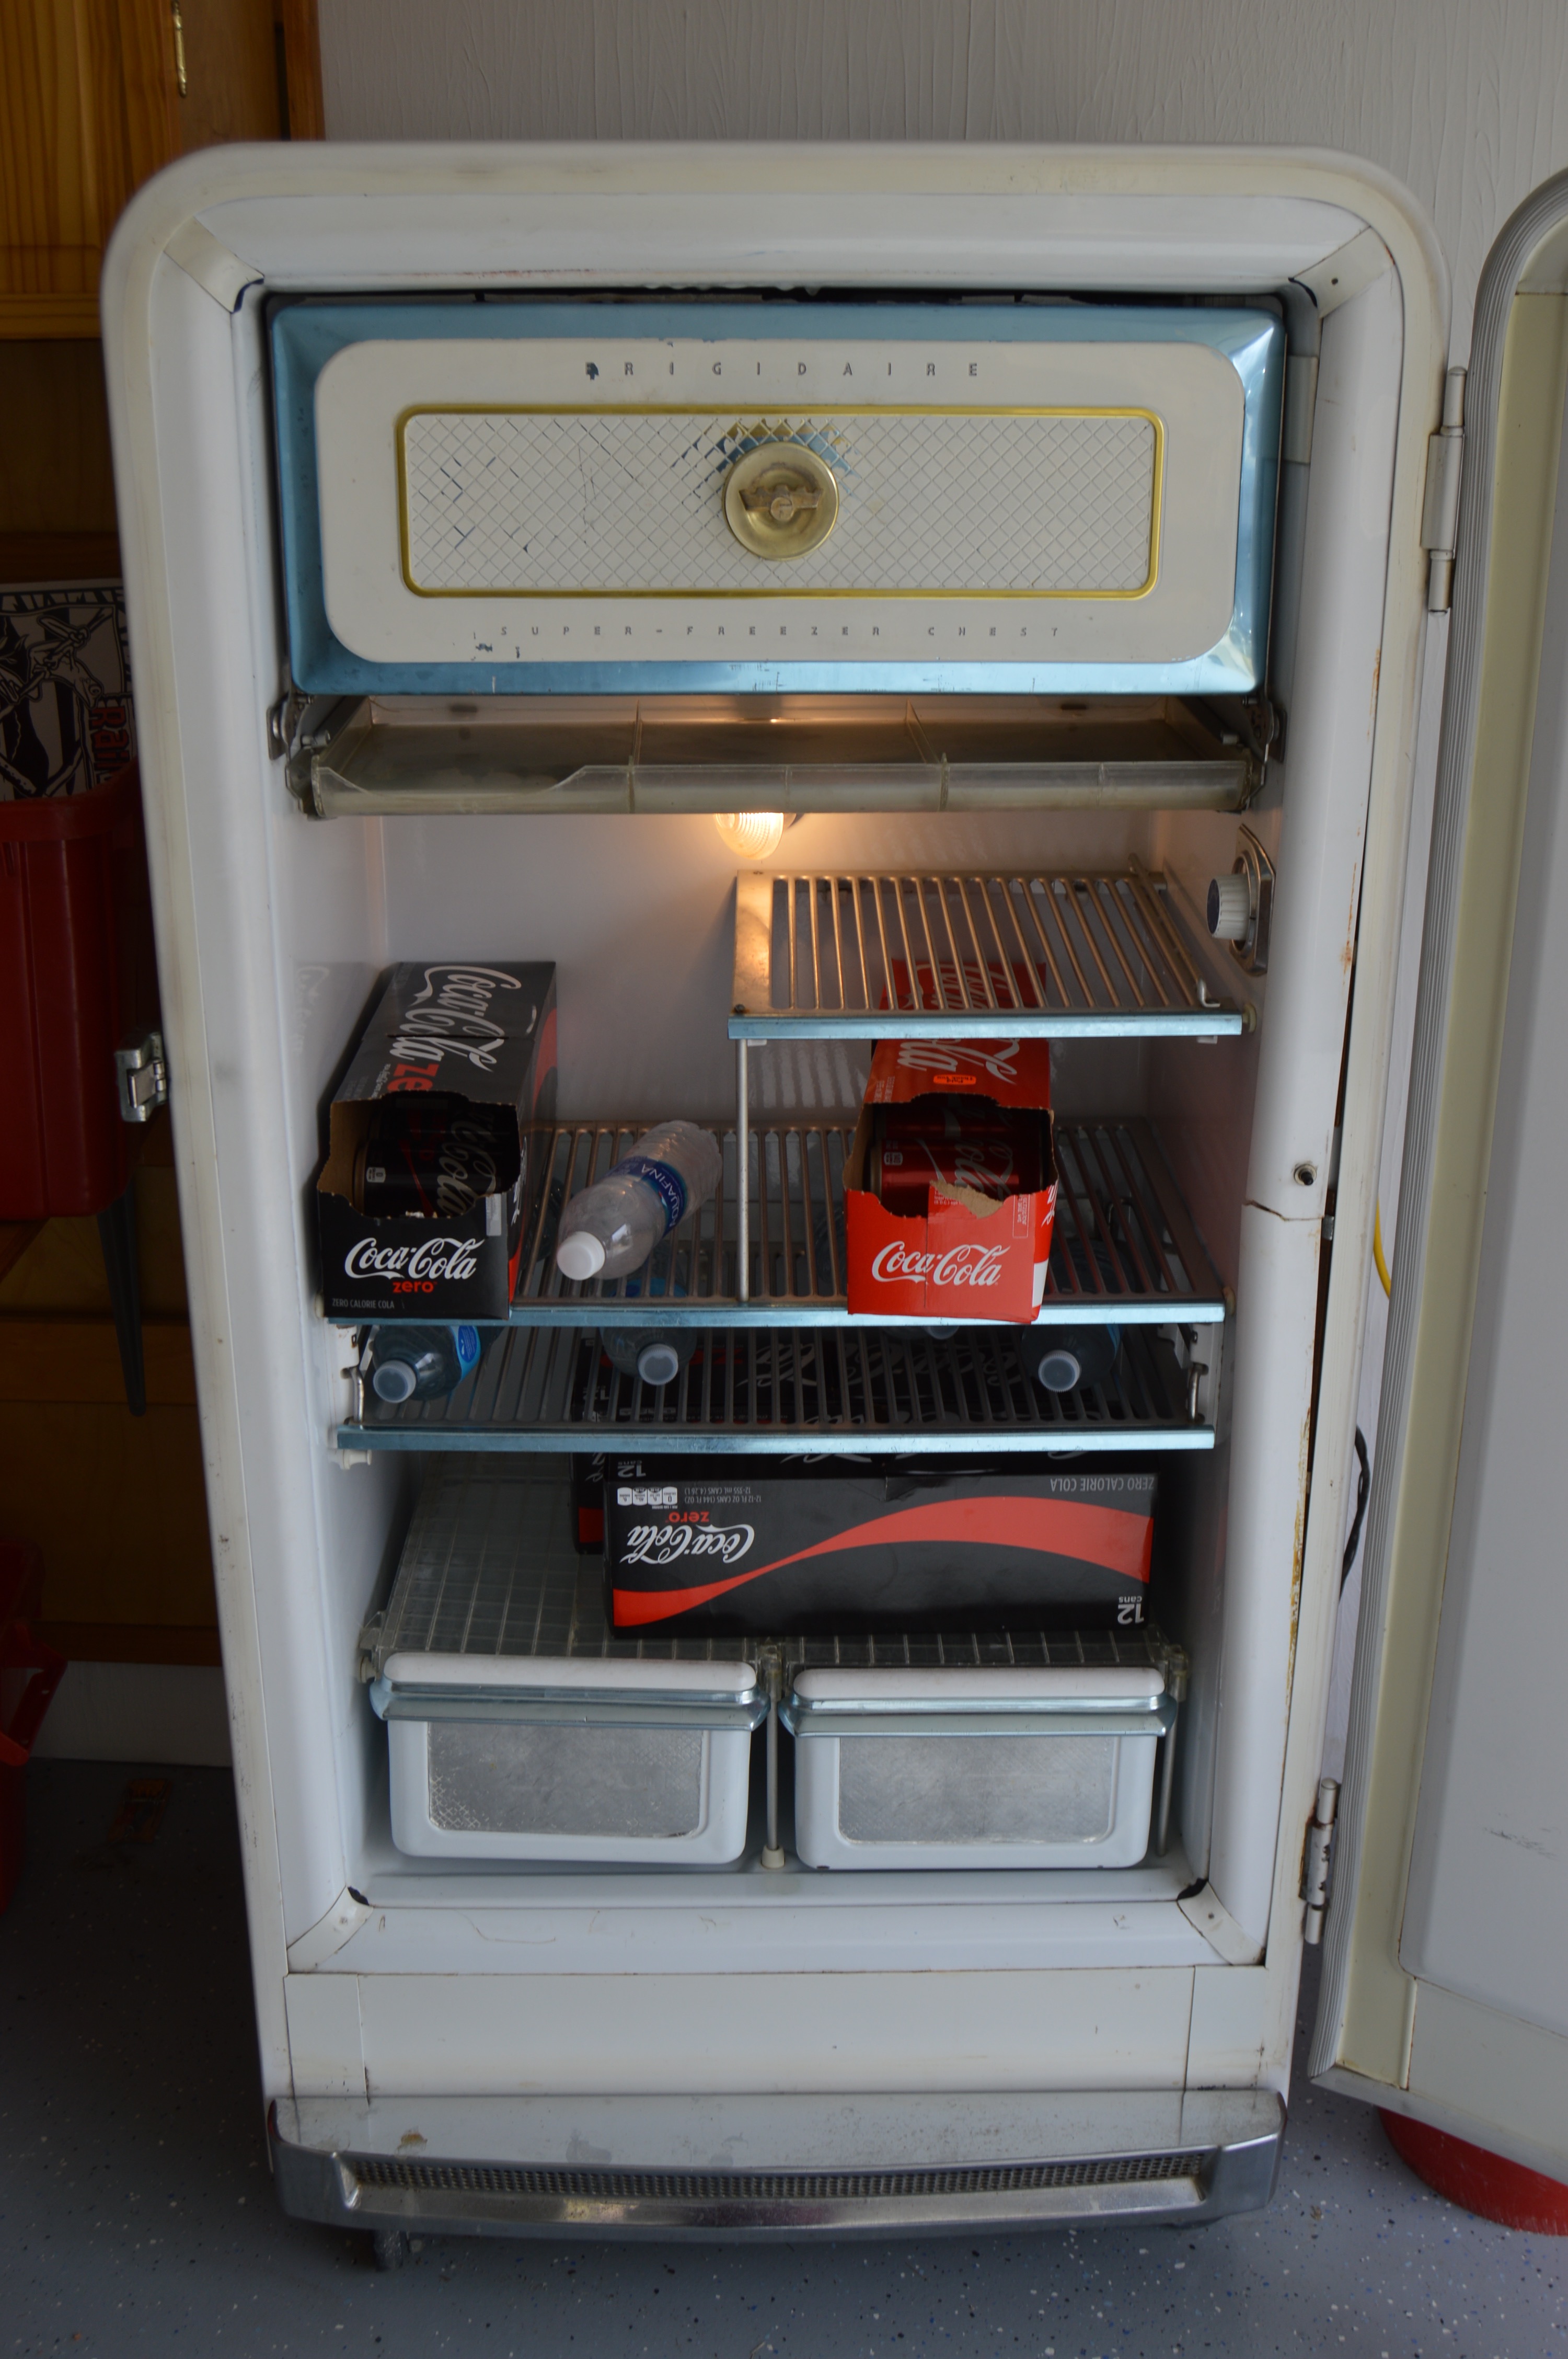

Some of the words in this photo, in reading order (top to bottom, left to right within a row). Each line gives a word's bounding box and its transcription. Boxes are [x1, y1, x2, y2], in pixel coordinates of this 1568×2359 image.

[500, 626, 880, 636] SUPER-FREEZER
[927, 626, 1058, 637] CHEST
[389, 965, 522, 1073] Coca-Cola
[387, 1063, 440, 1091] ze
[641, 1163, 680, 1228] AQUAFINA
[344, 1237, 486, 1280] Coca-Cola
[872, 1240, 1011, 1286] Coca-Cola
[393, 1280, 434, 1293] zero
[331, 1298, 349, 1308] ZERO
[350, 1298, 377, 1309] CALORIE
[378, 1299, 395, 1310] COLA
[617, 1464, 647, 1479] 12
[708, 1486, 722, 1495] CANS
[1050, 1478, 1077, 1492] COLA
[1079, 1477, 1124, 1492] CALORIE
[1127, 1476, 1155, 1491] ZERO
[716, 1495, 731, 1504] CANS
[668, 1511, 710, 1523] zero
[619, 1524, 755, 1564] Coca-Cola
[1119, 1596, 1143, 1604] cans
[1117, 1604, 1145, 1625] 12
